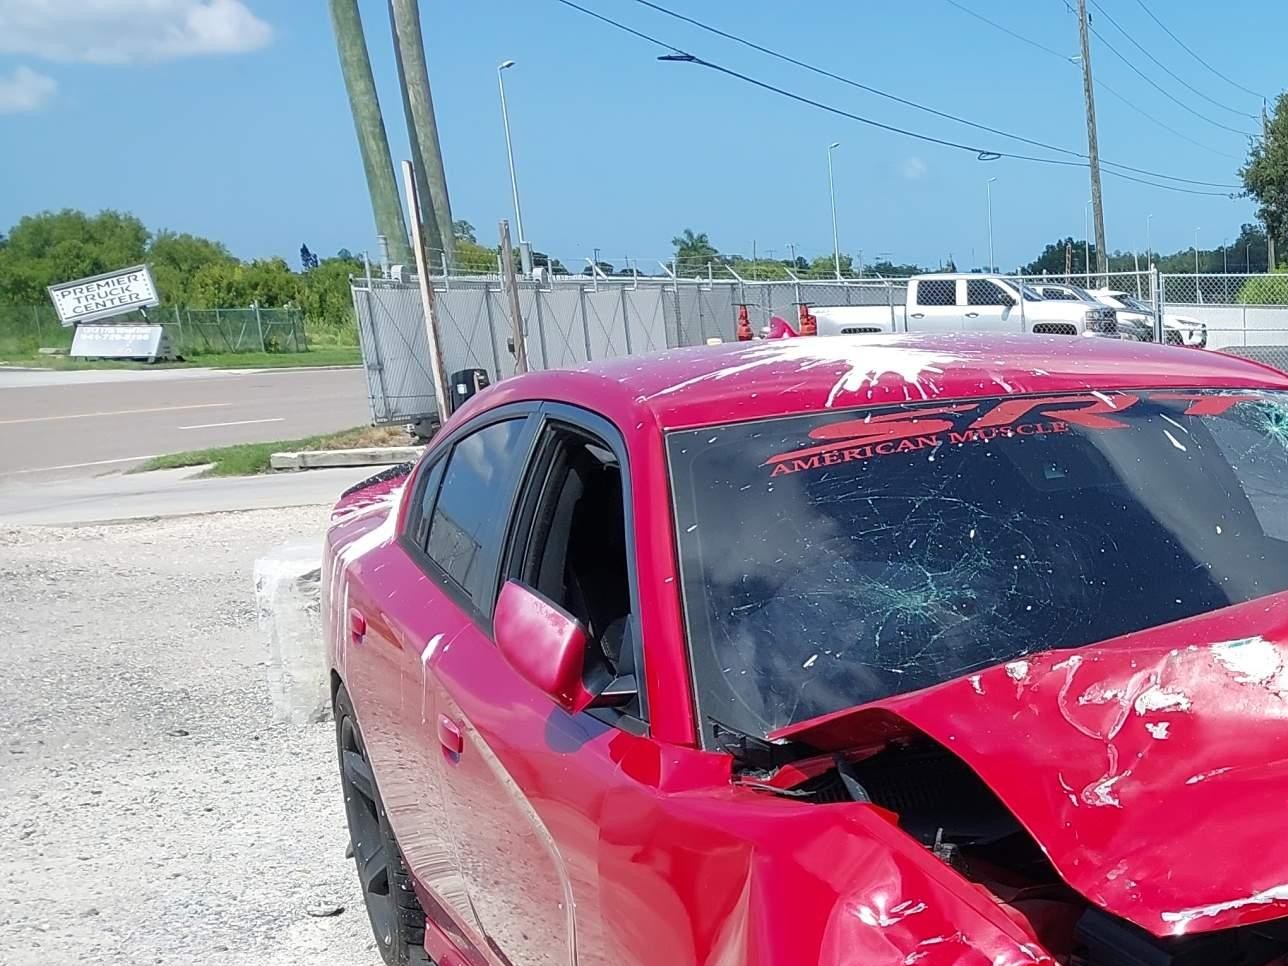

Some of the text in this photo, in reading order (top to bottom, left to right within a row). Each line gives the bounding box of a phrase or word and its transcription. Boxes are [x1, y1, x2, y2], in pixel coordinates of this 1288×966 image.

[60, 274, 139, 299] PREMIER
[73, 285, 133, 304] TRUCK
[72, 293, 141, 315] CENTER
[764, 393, 1250, 466] SRT
[769, 420, 1070, 477] AMERICAN MUSCLE
